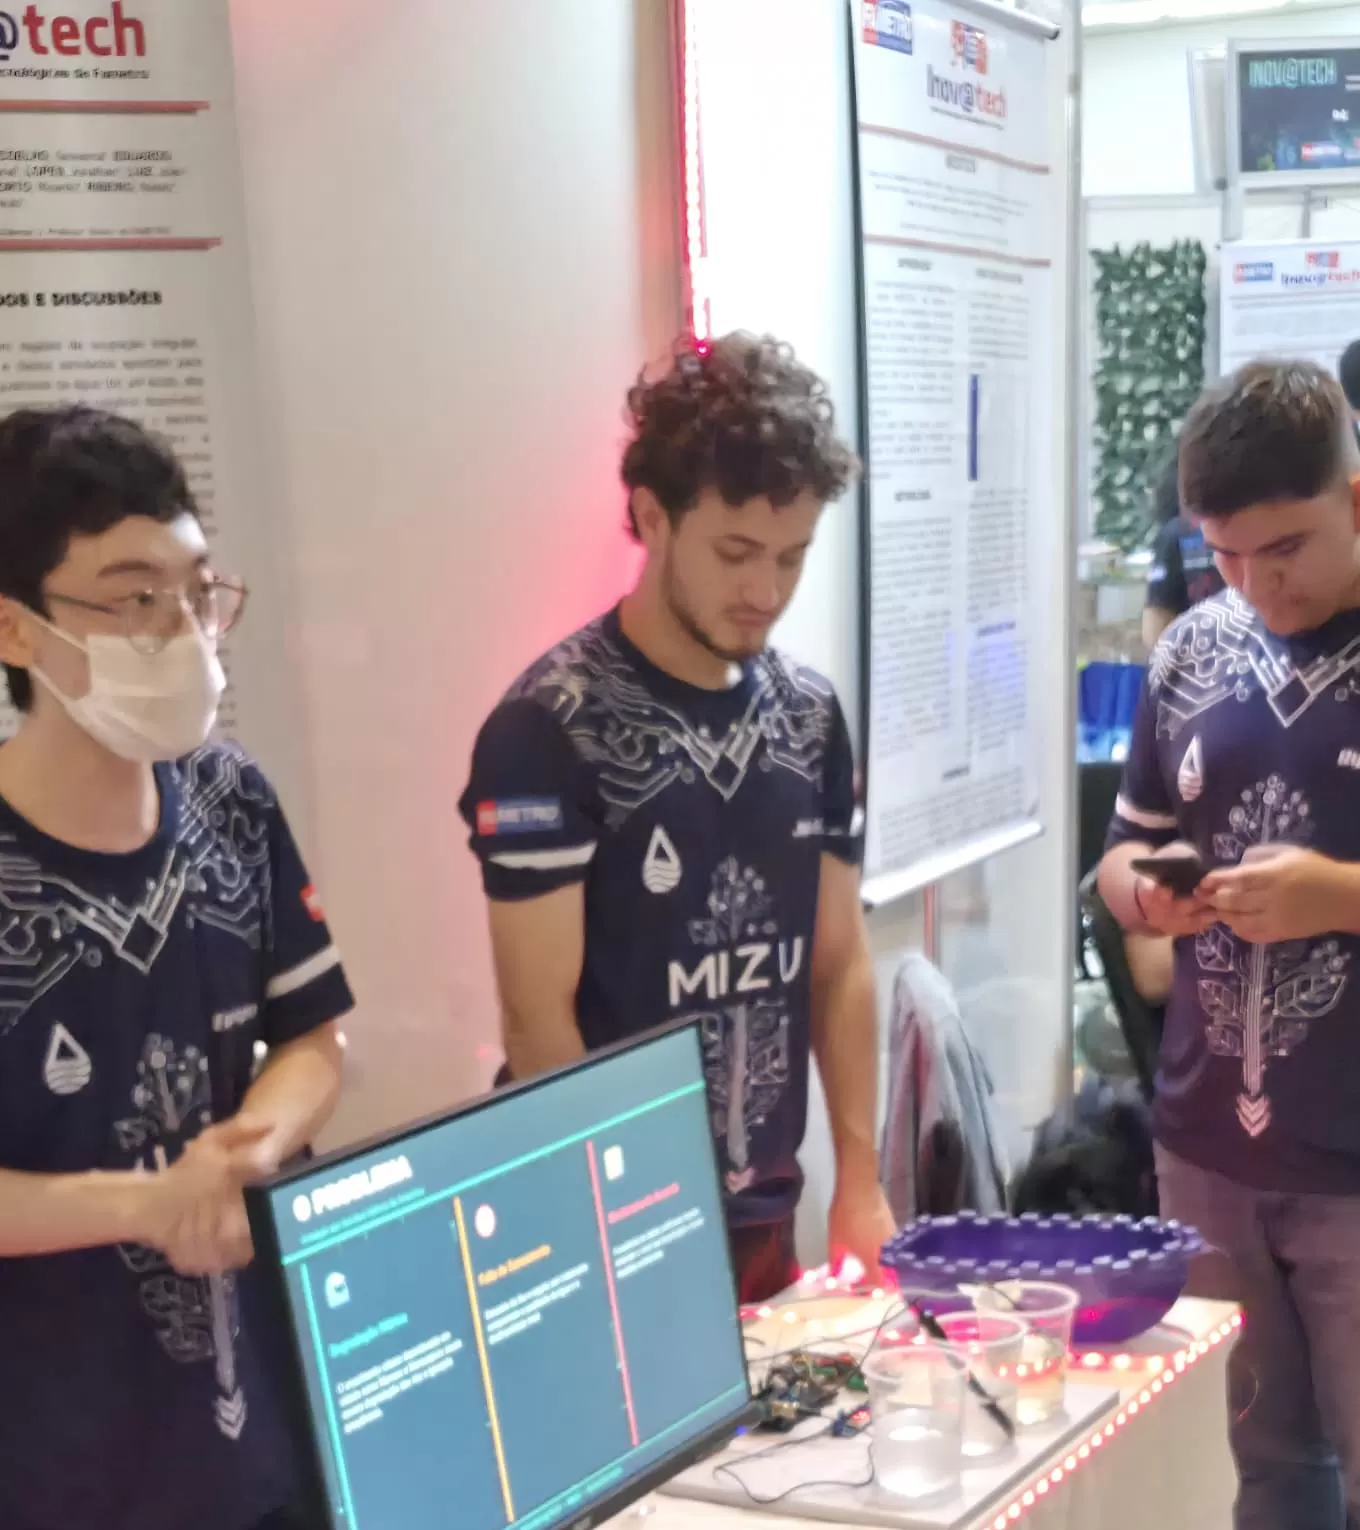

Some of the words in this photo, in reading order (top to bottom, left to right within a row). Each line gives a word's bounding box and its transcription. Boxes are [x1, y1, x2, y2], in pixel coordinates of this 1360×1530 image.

[35, 293, 46, 308] E
[51, 289, 163, 308] DISCUSSÕES
[668, 936, 803, 1006] MIZU
